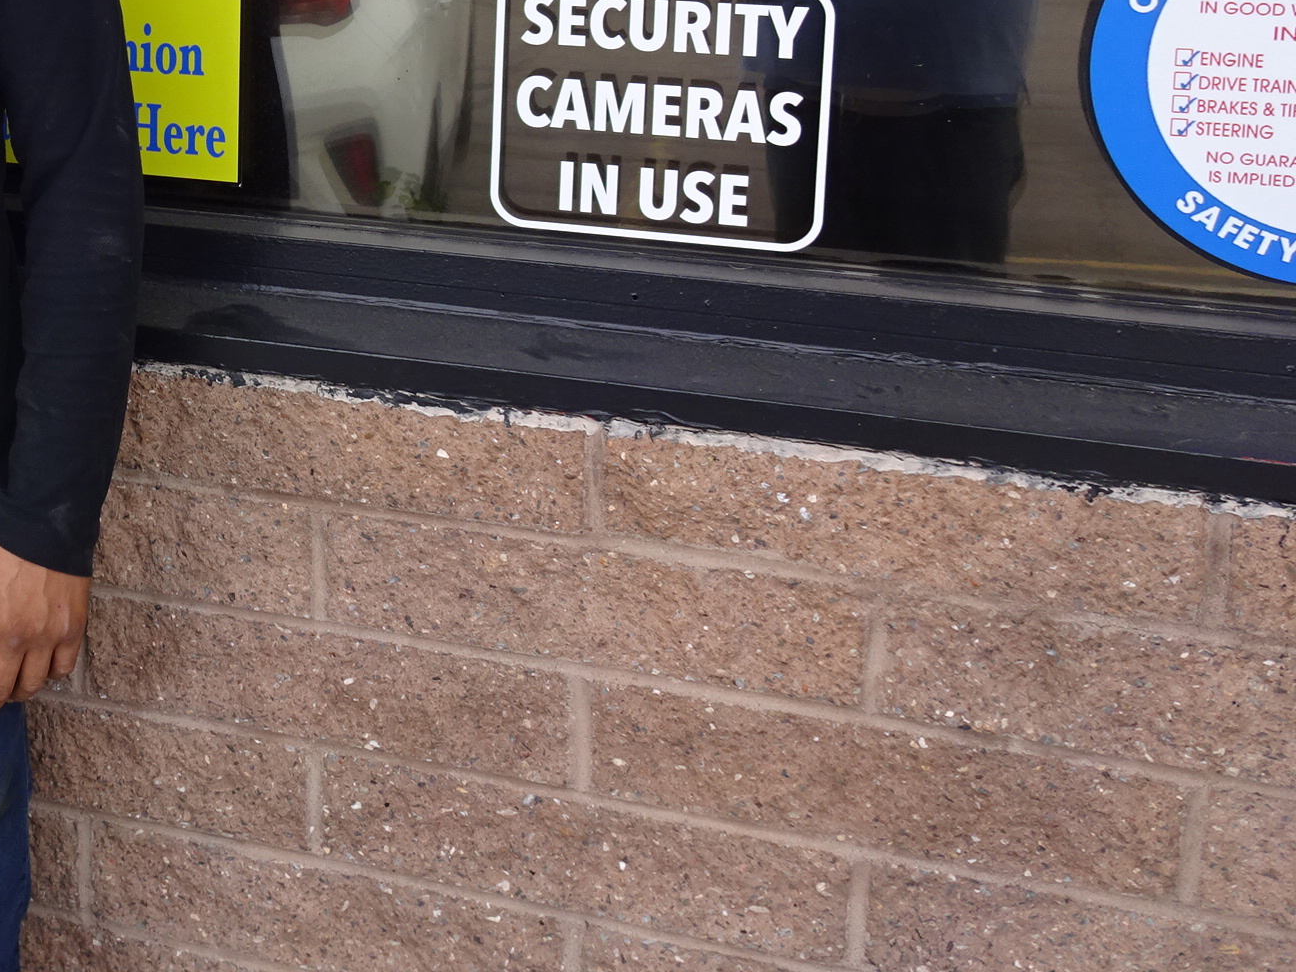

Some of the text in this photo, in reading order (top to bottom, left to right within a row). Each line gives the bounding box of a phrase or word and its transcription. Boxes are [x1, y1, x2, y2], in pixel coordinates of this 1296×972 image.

[1200, 1, 1218, 14] IN
[1224, 1, 1286, 16] GOOD
[1200, 51, 1264, 68] ENGINE
[1198, 75, 1248, 92] DRIVE
[516, 75, 804, 147] CAMERAS
[1196, 99, 1258, 116] BRAKES
[1263, 102, 1275, 117] &
[134, 103, 226, 158] Here
[1195, 121, 1274, 140] STEERING
[1206, 151, 1234, 165] NO
[1208, 170, 1296, 188] IS IMPLIED
[558, 160, 749, 227] IN USE
[1176, 190, 1296, 263] SAFETY
